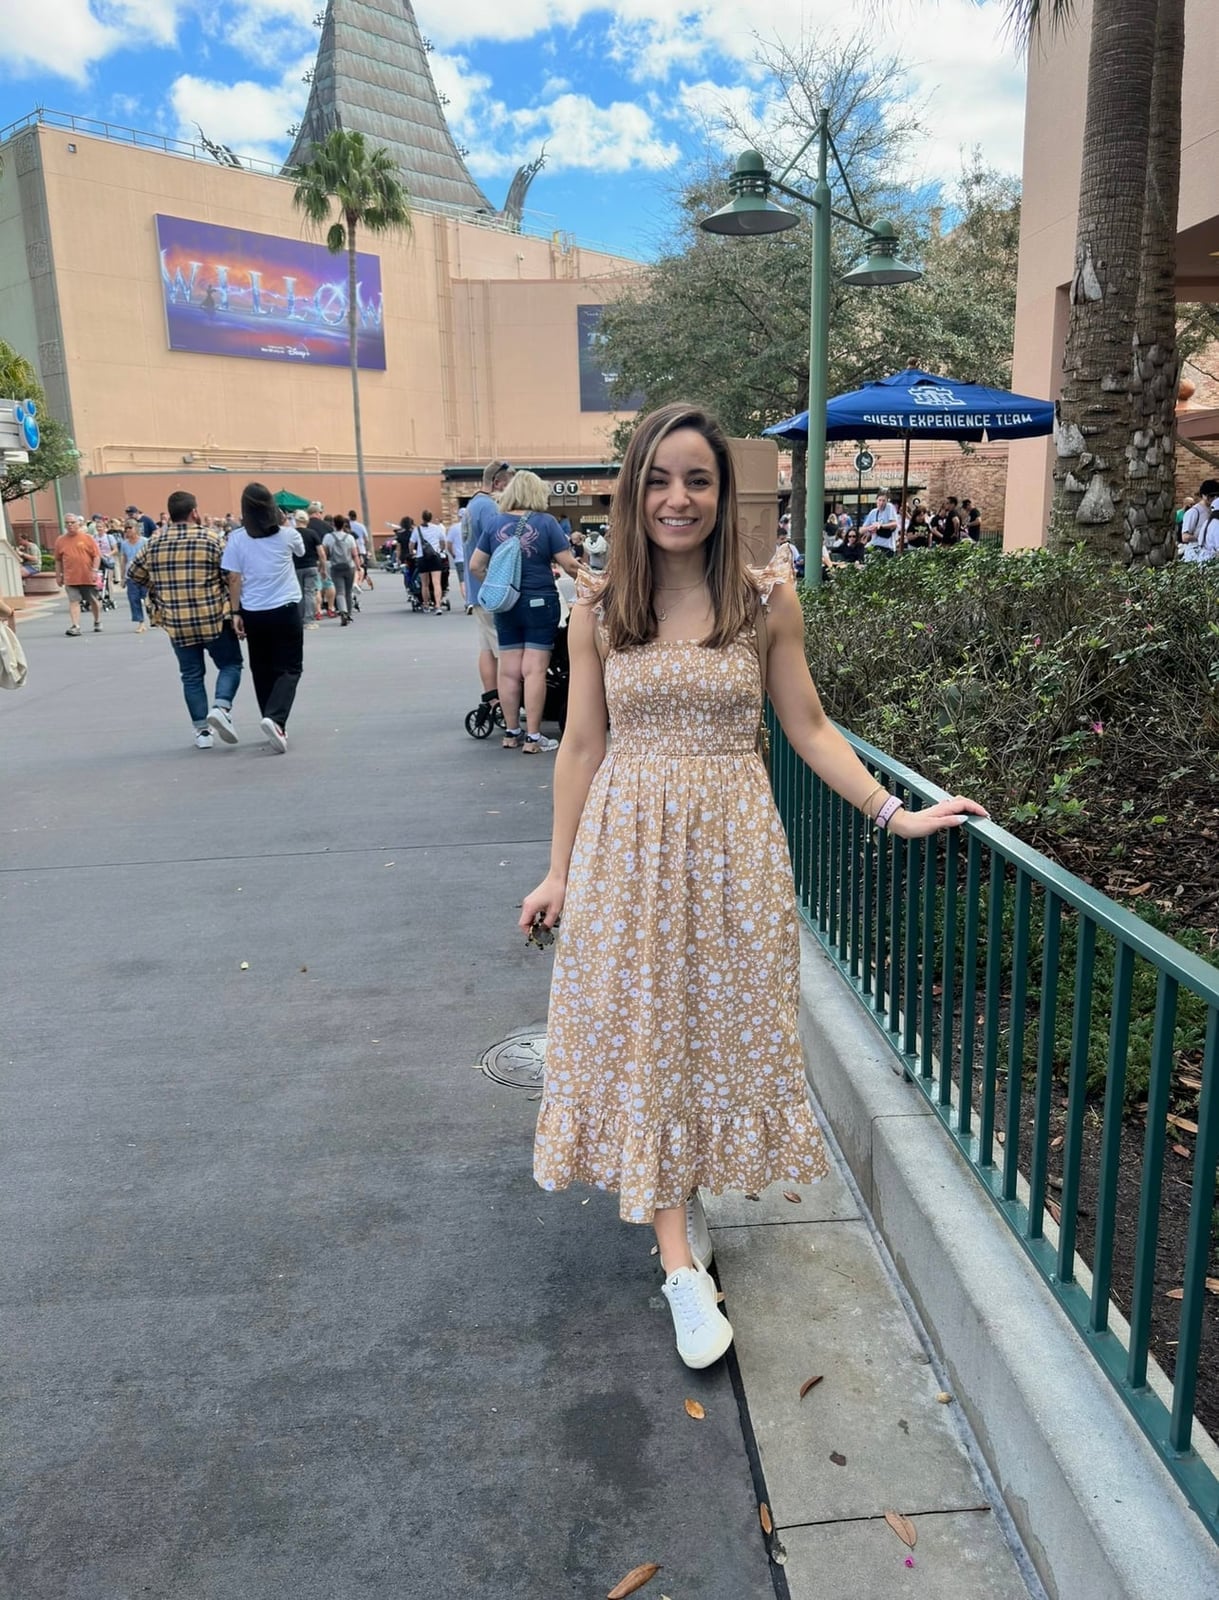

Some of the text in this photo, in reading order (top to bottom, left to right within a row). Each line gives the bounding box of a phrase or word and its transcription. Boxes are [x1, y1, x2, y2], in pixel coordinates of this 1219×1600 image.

[159, 248, 383, 330] WILLOW
[863, 414, 1033, 427] GUEST EXPERIENCE TEAM
